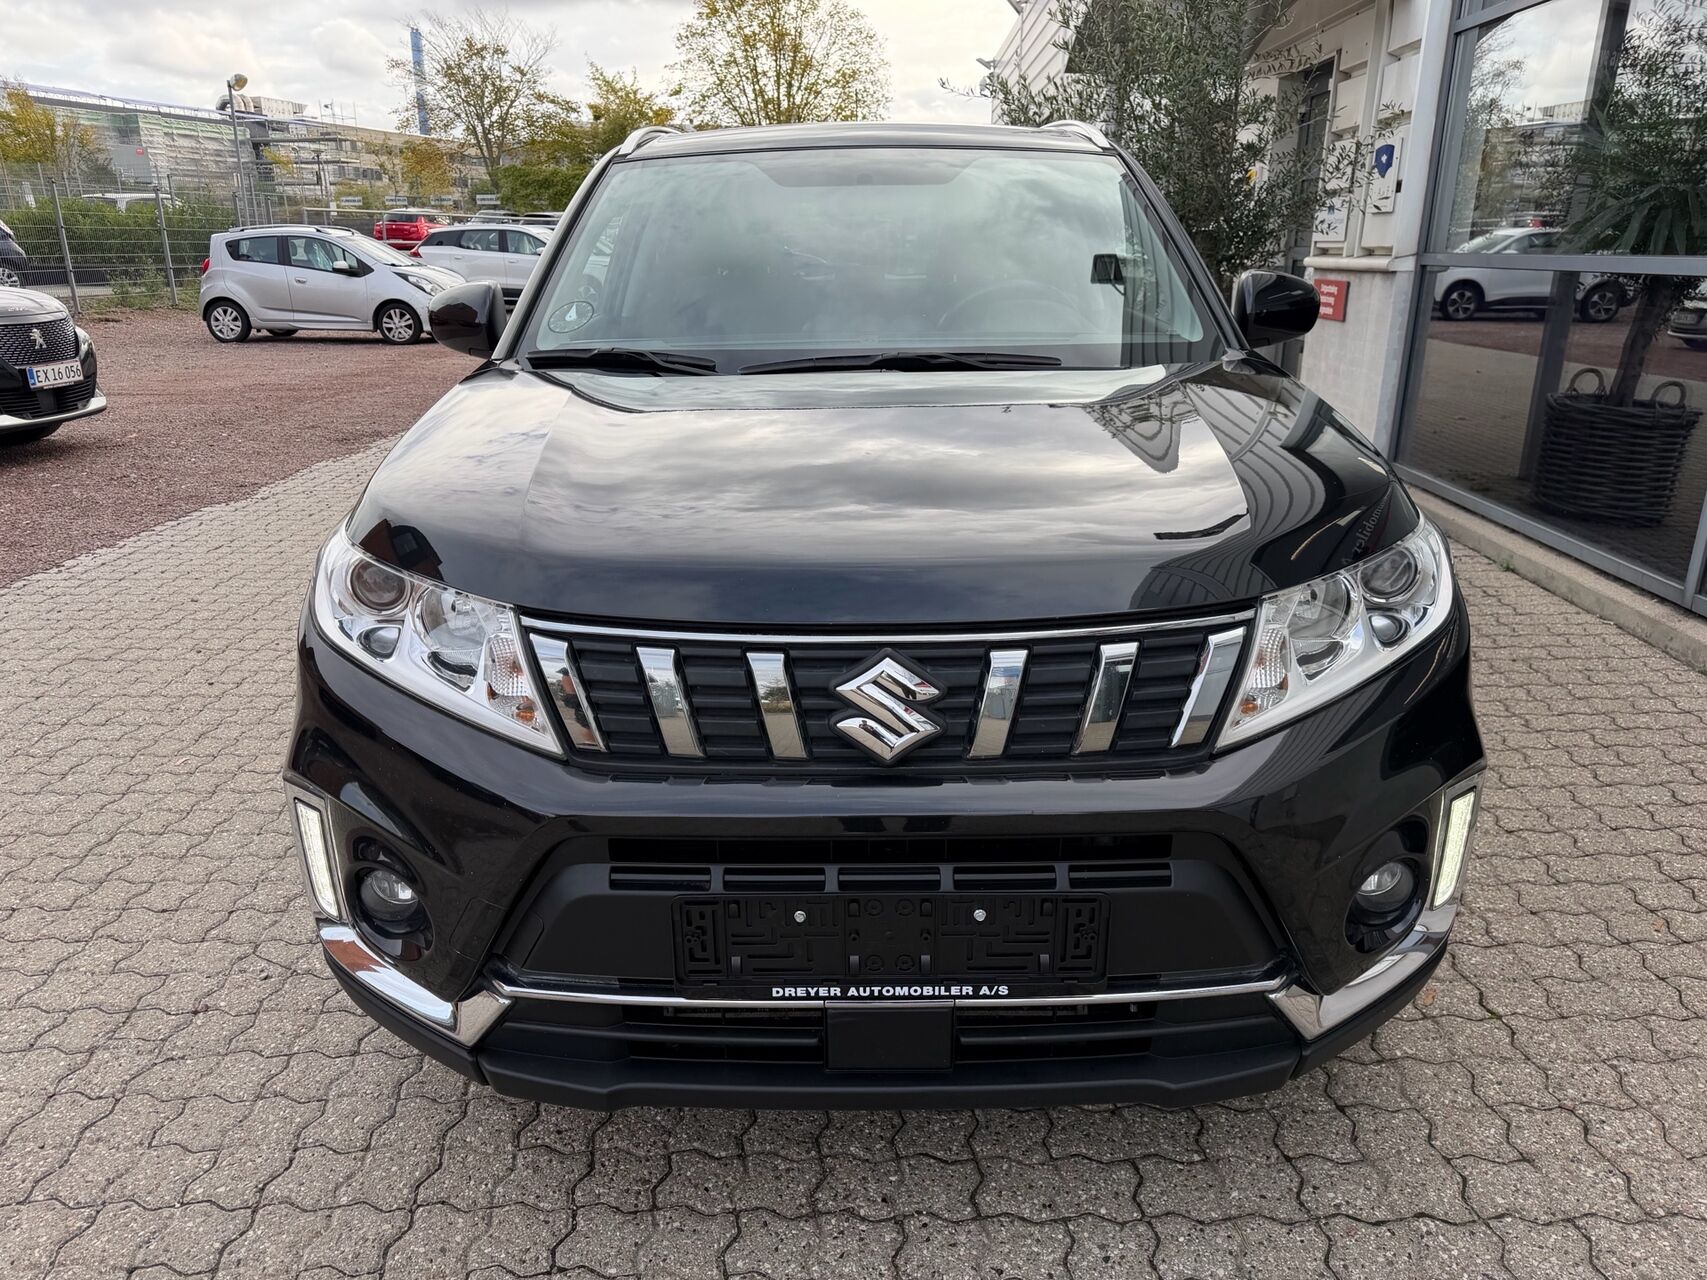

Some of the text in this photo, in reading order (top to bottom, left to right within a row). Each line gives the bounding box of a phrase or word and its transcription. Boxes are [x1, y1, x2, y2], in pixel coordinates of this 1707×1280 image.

[35, 364, 82, 384] EX 16 056
[771, 985, 1010, 998] DREYER AUTOMOBILER A/S
